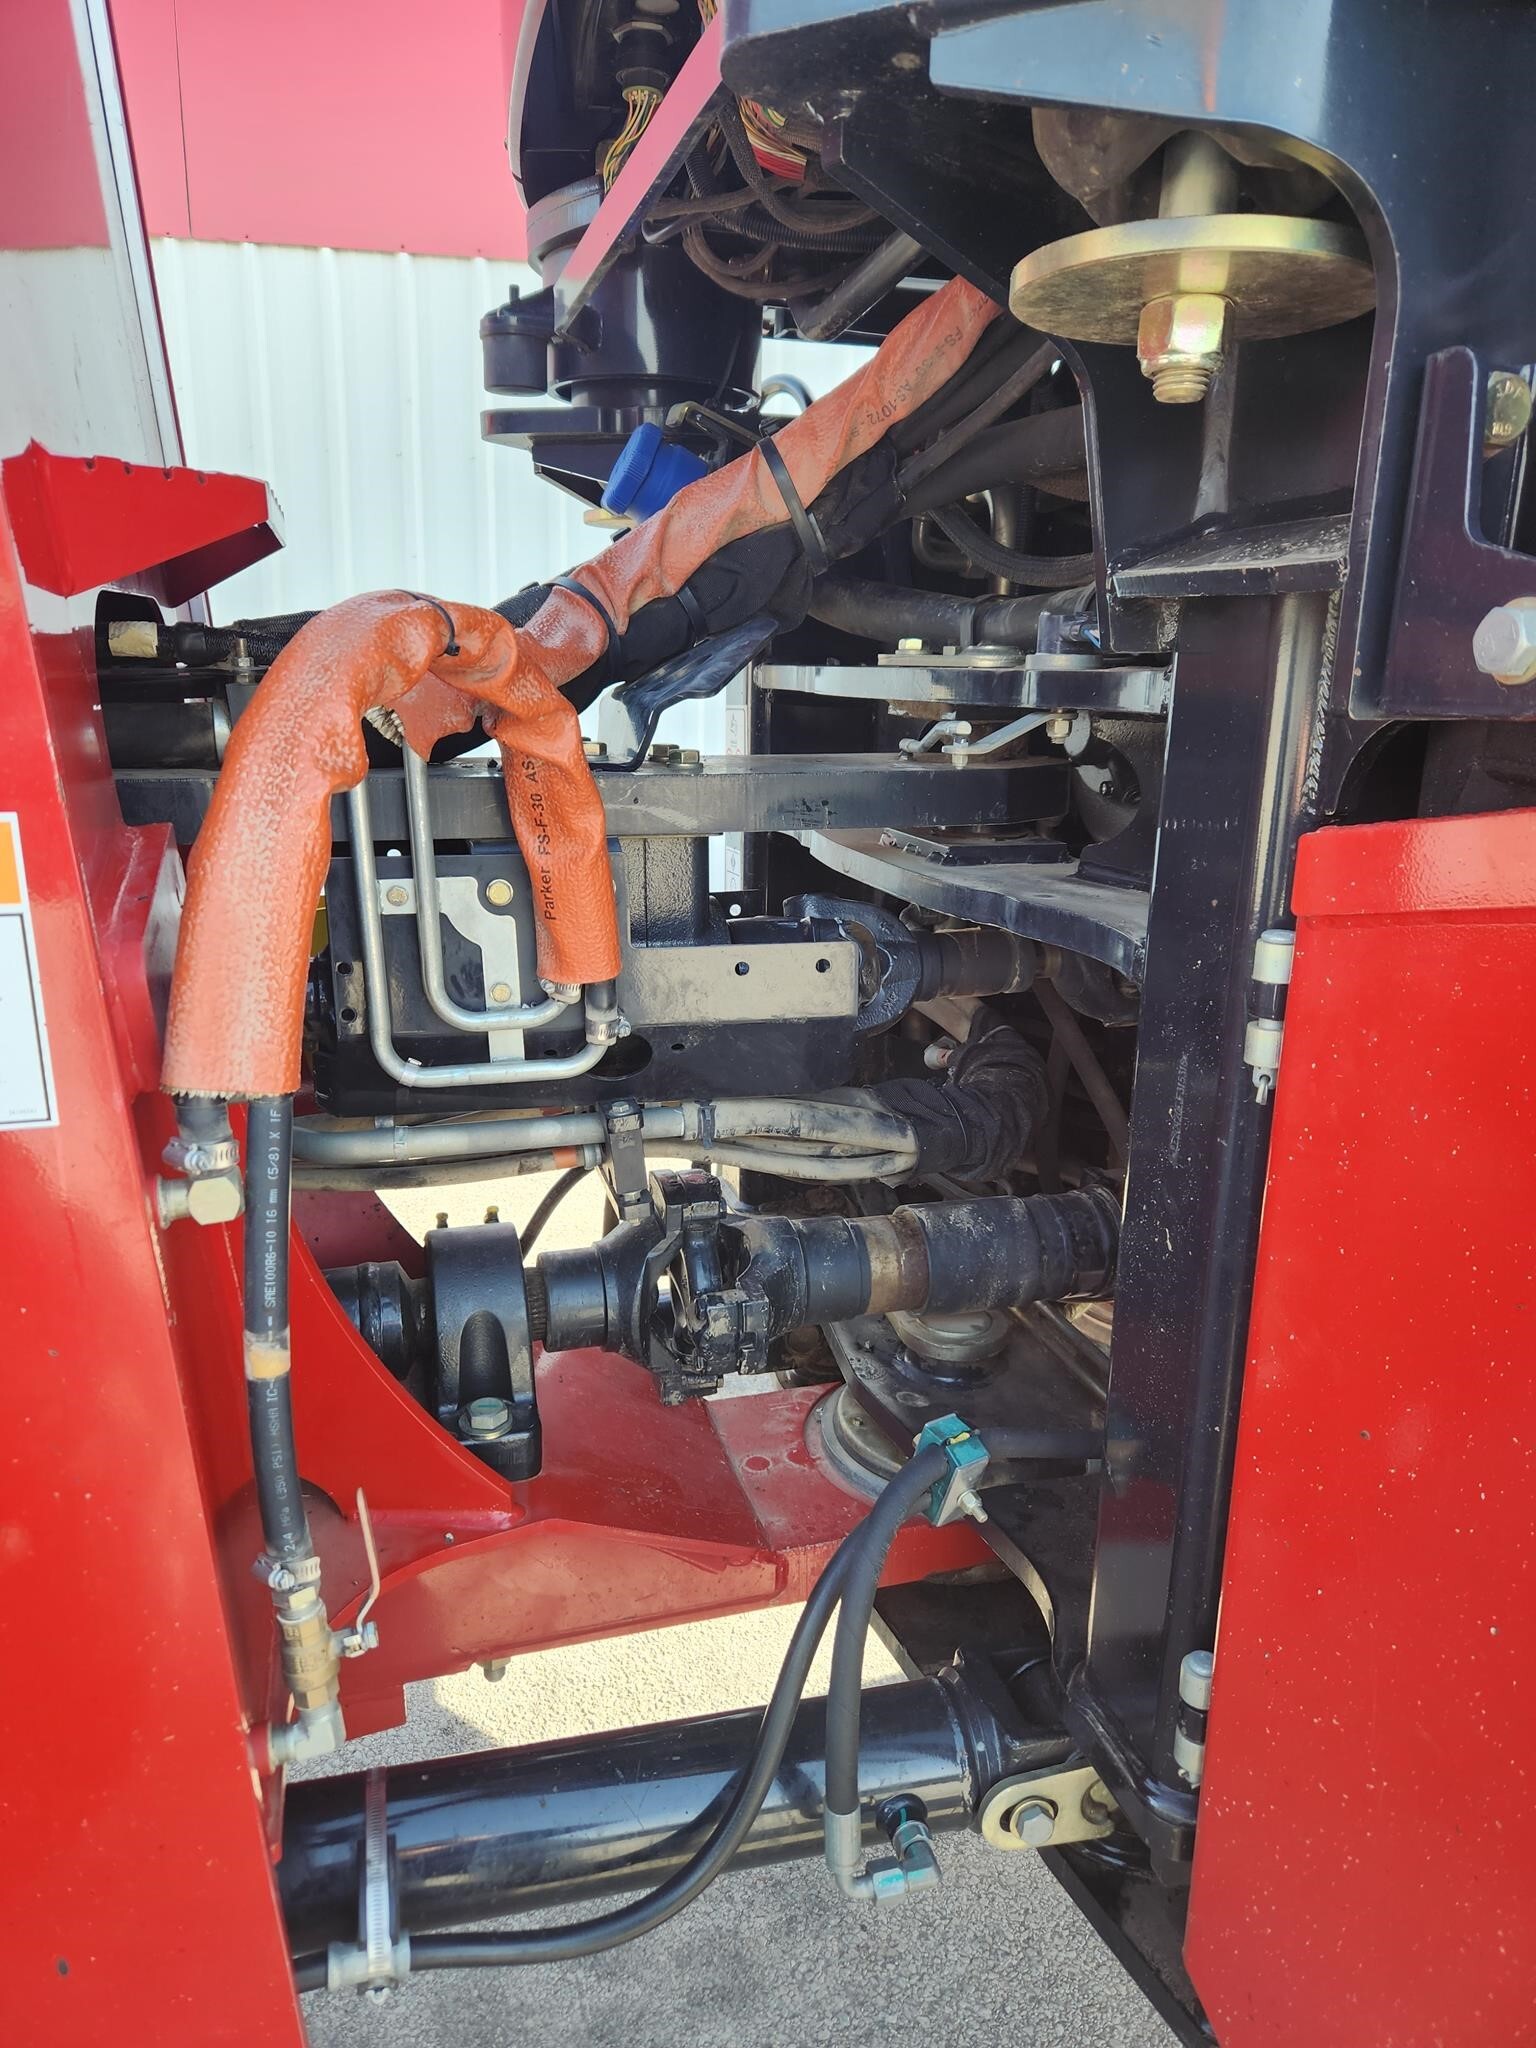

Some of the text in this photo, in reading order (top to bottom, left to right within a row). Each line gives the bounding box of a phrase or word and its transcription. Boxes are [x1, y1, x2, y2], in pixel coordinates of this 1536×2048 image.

[530, 793, 551, 856] FS-F-30
[540, 865, 557, 921] Parker
[269, 1131, 281, 1140] X
[267, 1147, 281, 1180] (5/8)
[269, 1188, 279, 1205] mm
[266, 1209, 278, 1224] 16
[264, 1230, 277, 1308] SAE100R6-10
